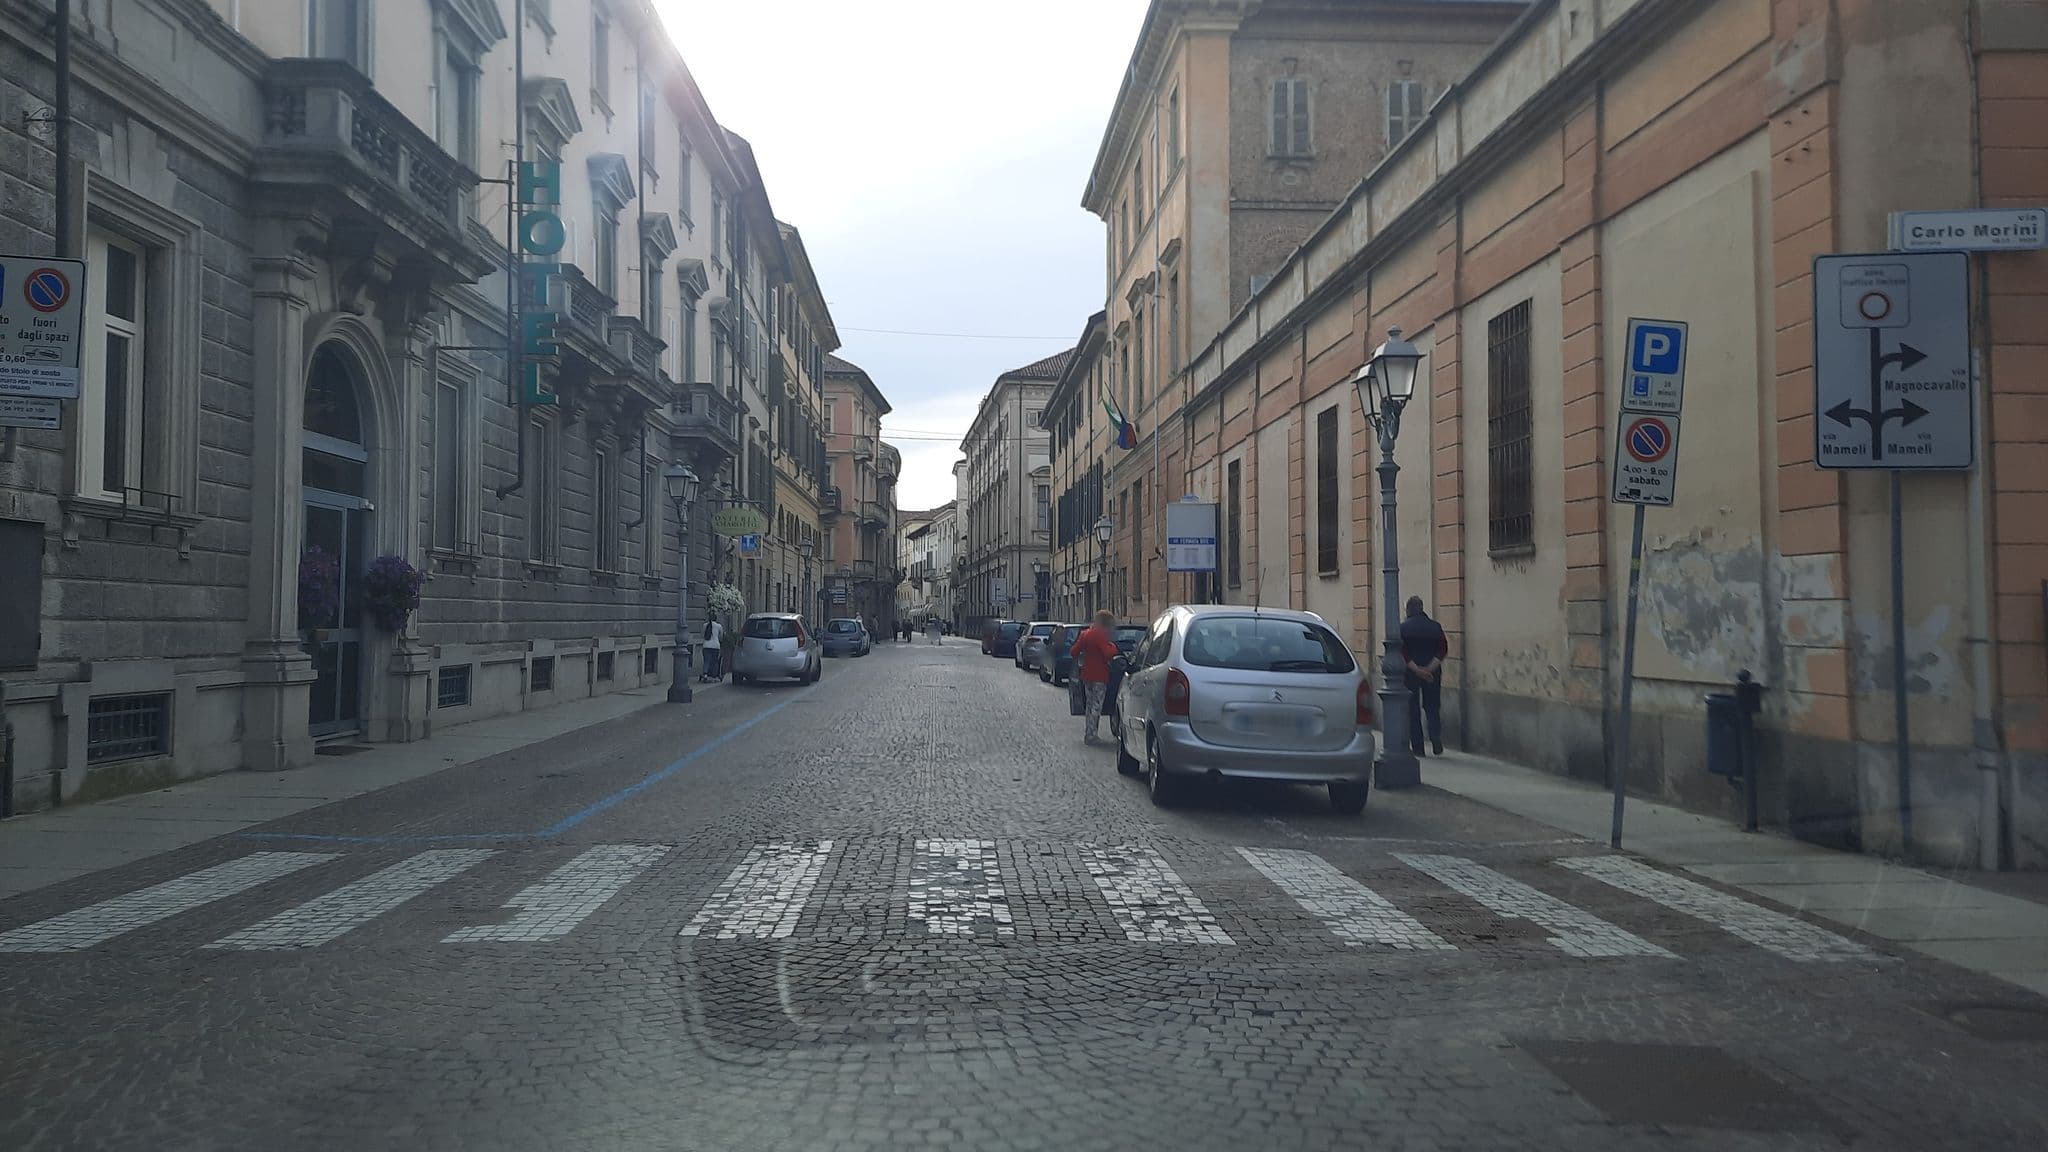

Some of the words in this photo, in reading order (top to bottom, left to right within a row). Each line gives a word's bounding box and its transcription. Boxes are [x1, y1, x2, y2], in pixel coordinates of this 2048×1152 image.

[1911, 226, 1965, 239] Carlo
[1973, 223, 2038, 237] Morini
[519, 161, 566, 405] HOTEL
[32, 316, 57, 328] fuori
[17, 328, 42, 342] dagli
[45, 332, 69, 344] spazi
[1643, 332, 1671, 367] P
[5, 355, 26, 363] 0,60
[11, 367, 30, 375] titolo
[1884, 379, 1967, 394] Magnocavallo
[1822, 444, 1866, 455] Mameli
[1887, 443, 1932, 455] Mameli
[1629, 476, 1661, 486] sabato
